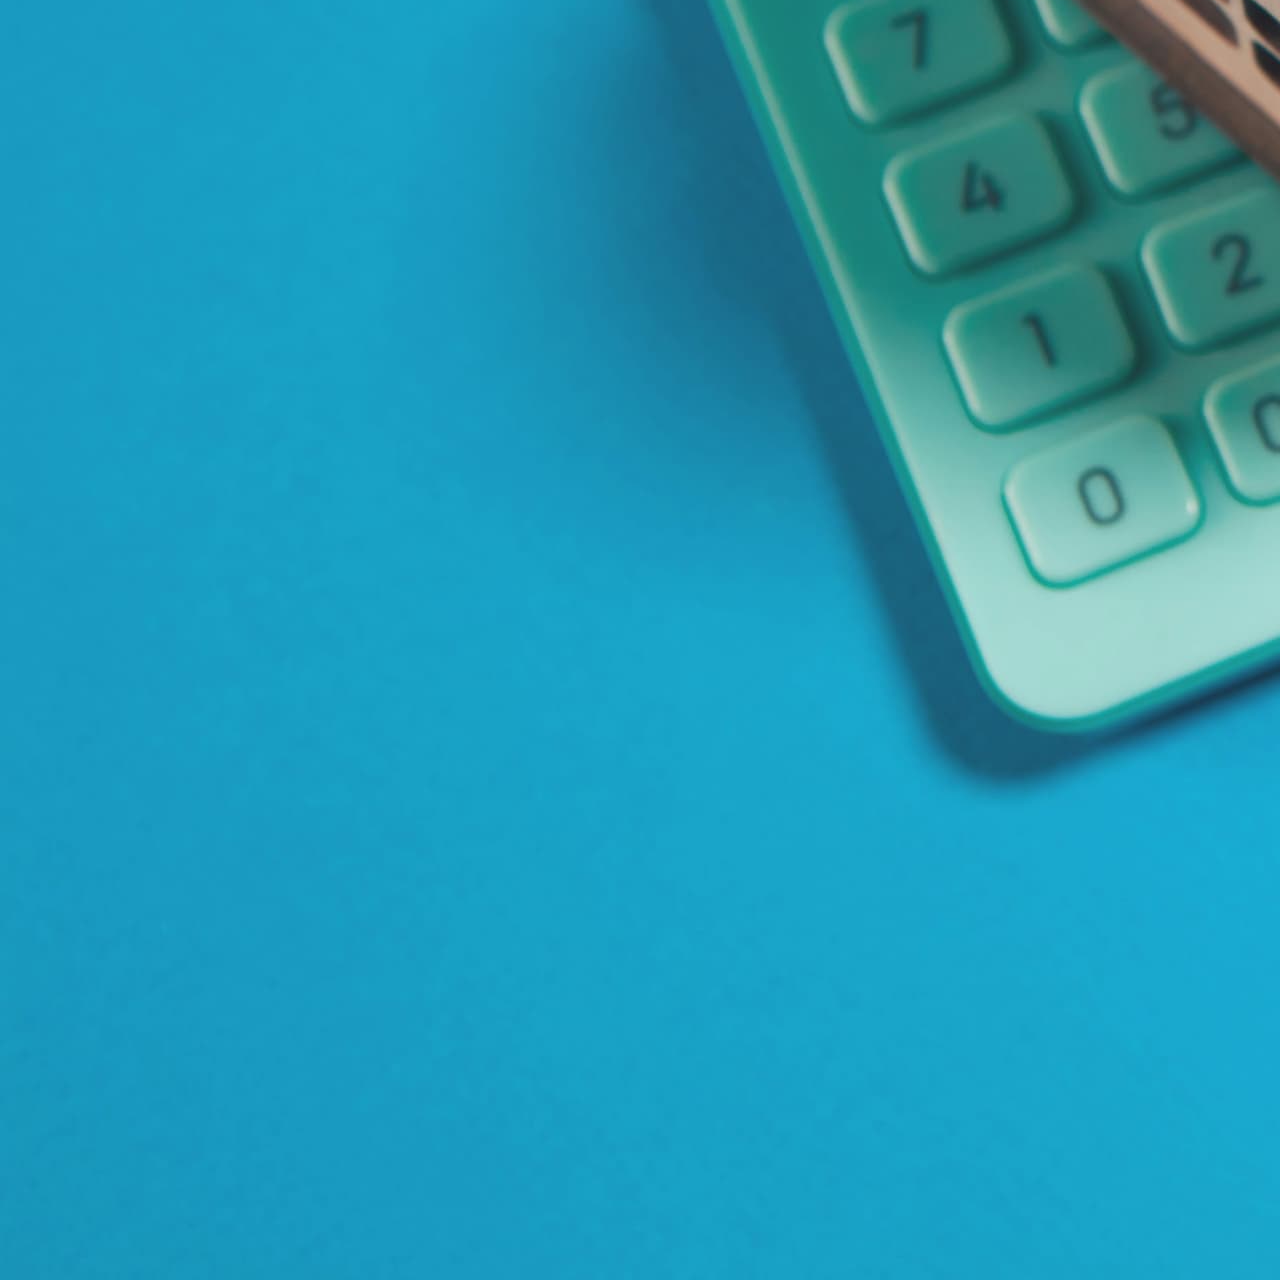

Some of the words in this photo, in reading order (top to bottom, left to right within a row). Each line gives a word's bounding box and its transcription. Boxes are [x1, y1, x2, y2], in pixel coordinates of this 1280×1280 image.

[889, 8, 929, 71] 7
[1149, 84, 1197, 140] 5
[958, 160, 1007, 214] 4
[1211, 233, 1263, 295] 2
[1022, 313, 1058, 368] 1
[1075, 466, 1126, 525] 0
